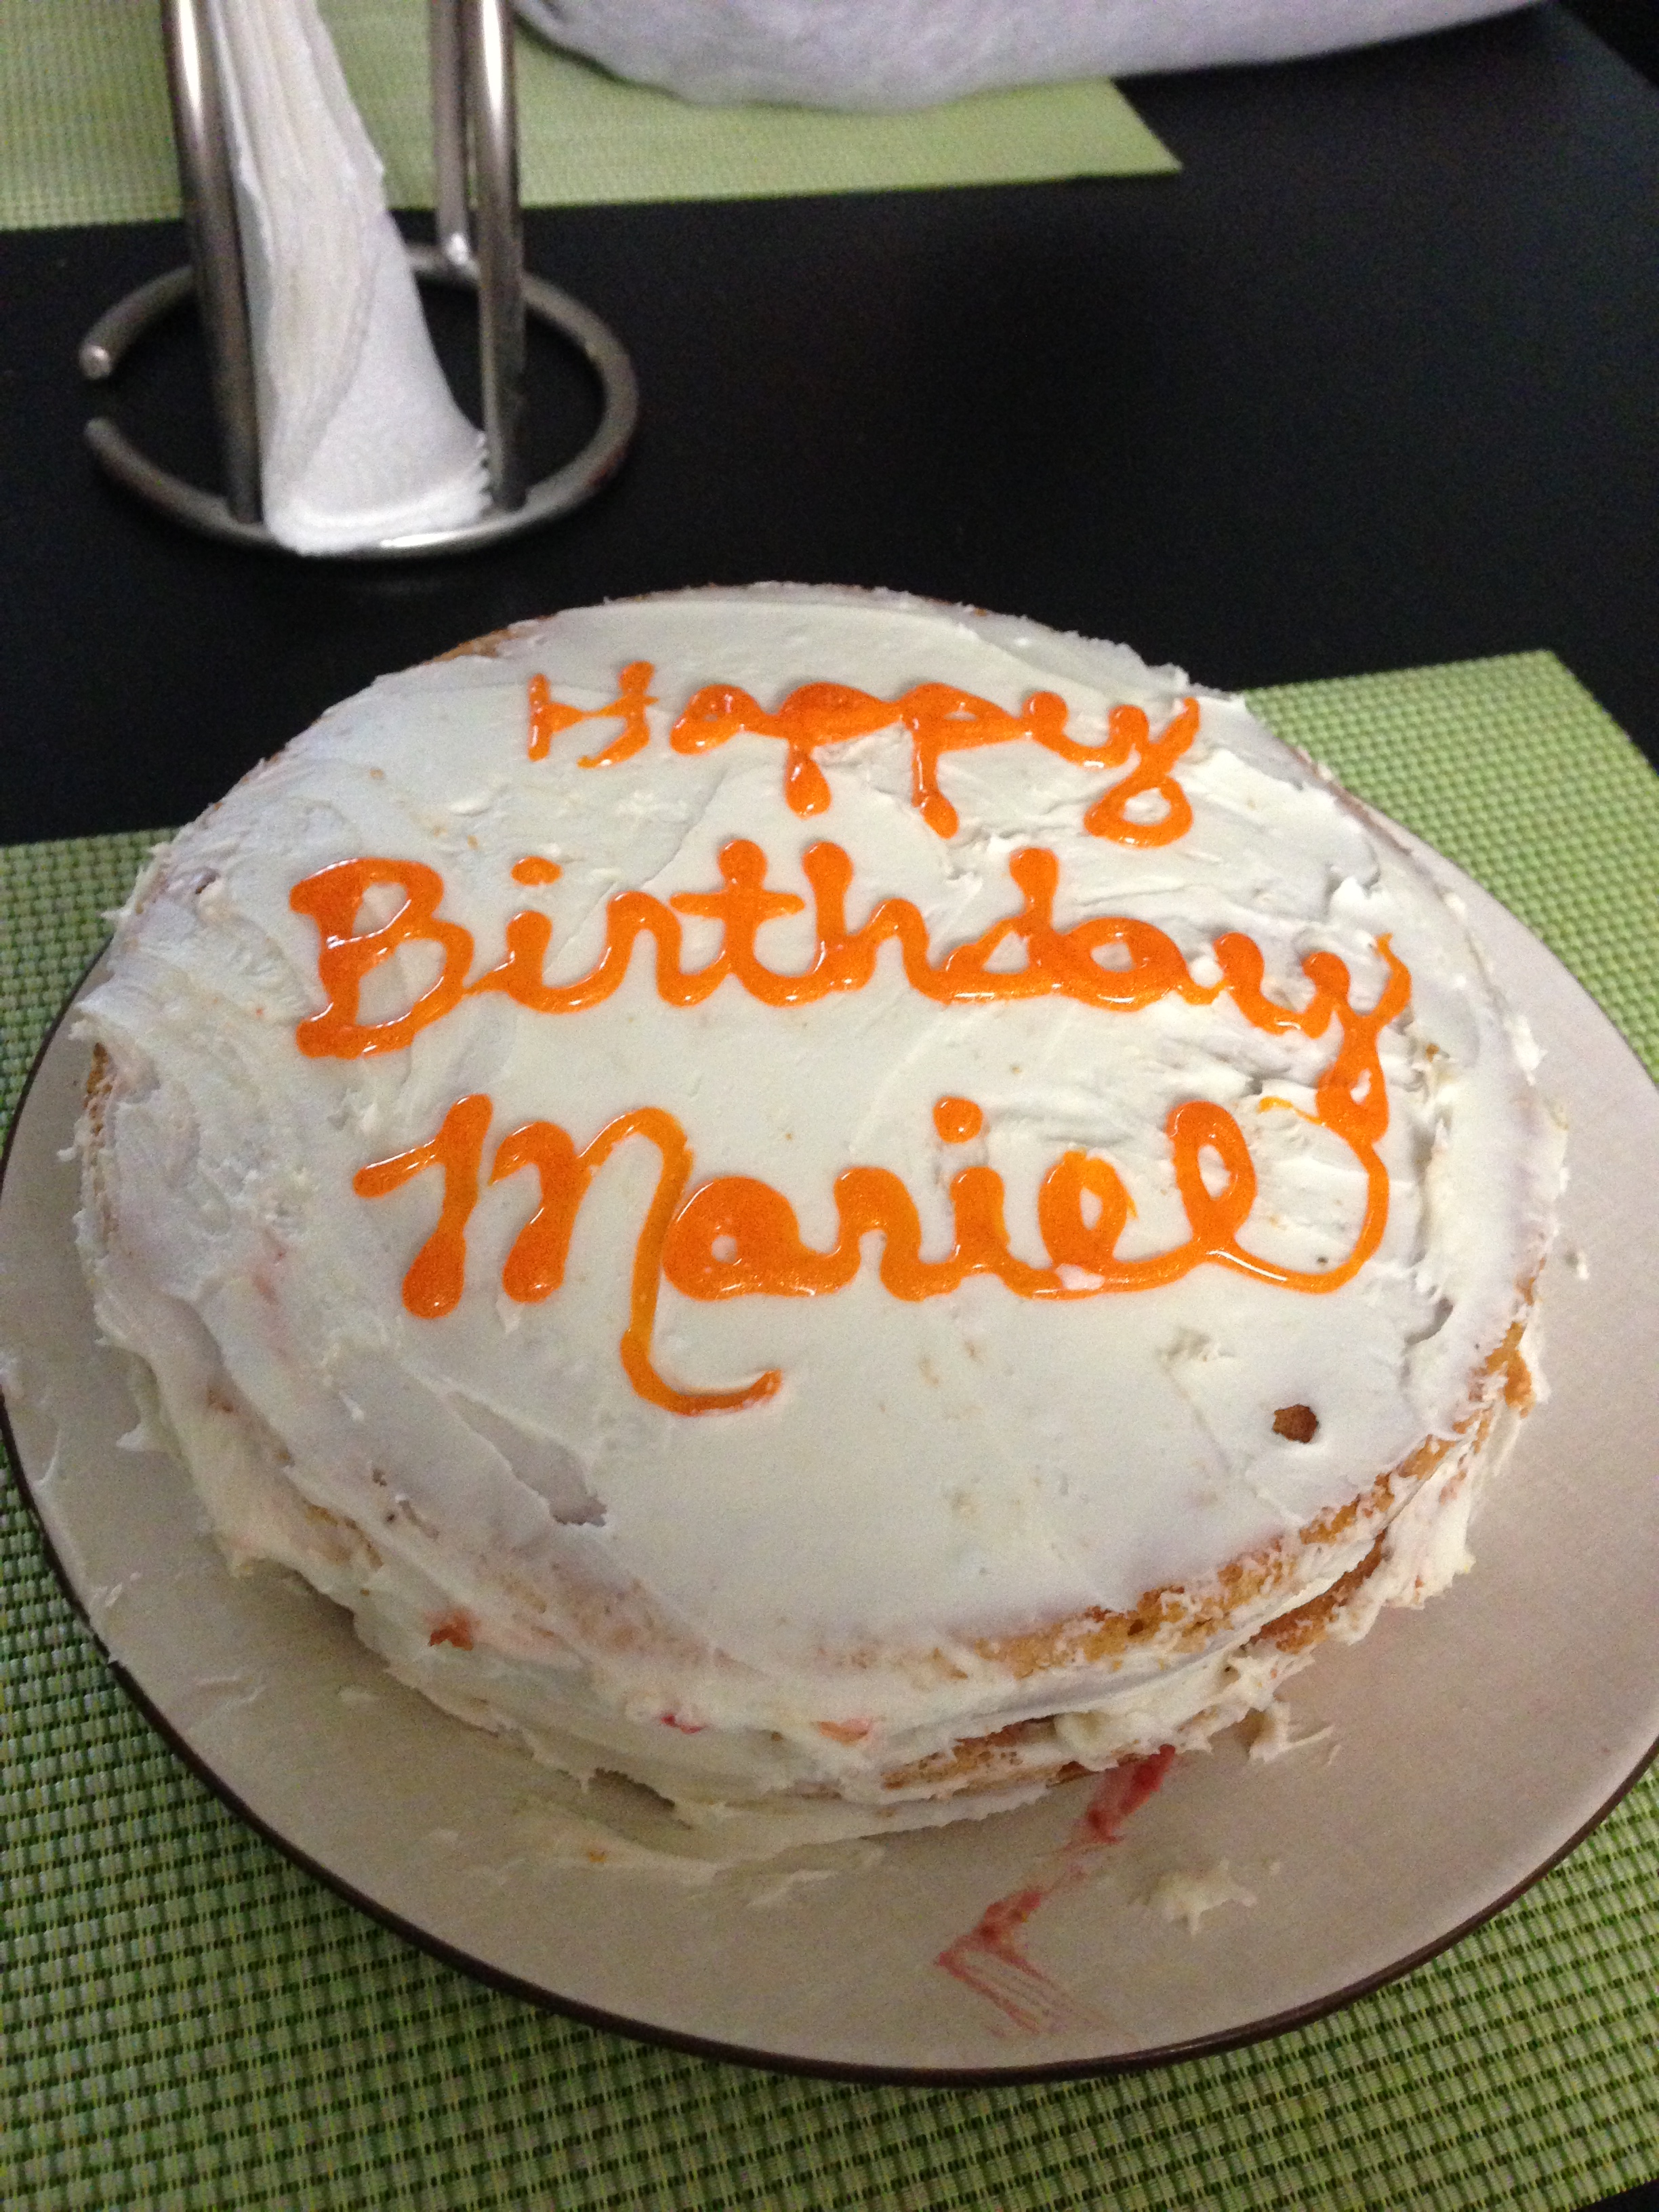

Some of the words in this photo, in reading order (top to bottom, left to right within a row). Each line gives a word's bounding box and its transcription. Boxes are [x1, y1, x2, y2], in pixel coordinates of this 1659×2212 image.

[527, 661, 1200, 848] Happy
[289, 839, 1412, 1147] Birthday
[352, 1094, 1389, 1417] Mariel
